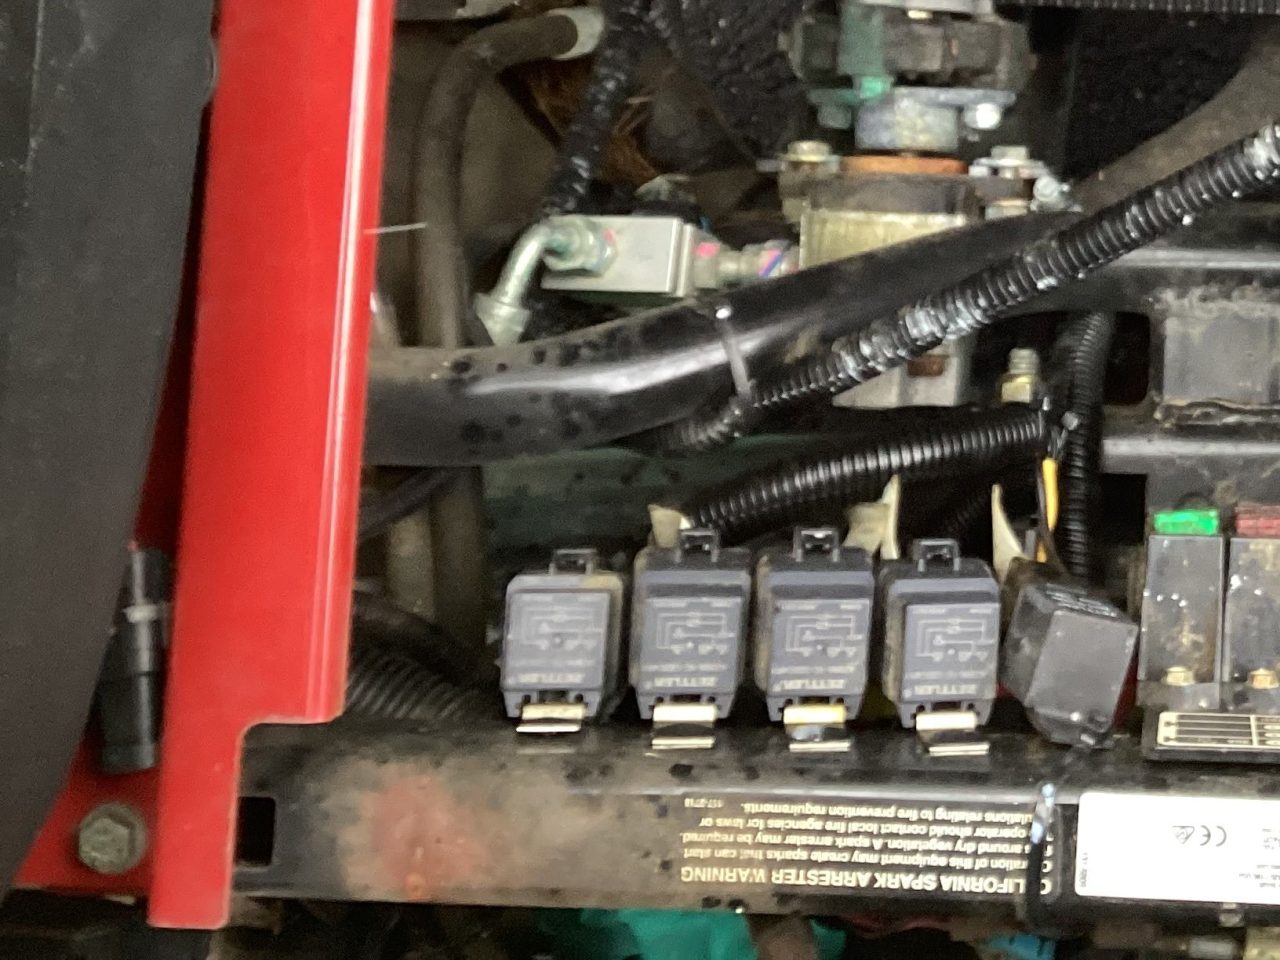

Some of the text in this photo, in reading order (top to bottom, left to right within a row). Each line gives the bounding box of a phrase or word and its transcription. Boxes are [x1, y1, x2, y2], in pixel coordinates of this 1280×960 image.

[740, 802, 827, 816] requirements.
[828, 804, 896, 818] prevention
[897, 809, 919, 822] fire
[919, 809, 934, 822] to
[934, 807, 983, 823] relating
[699, 817, 713, 827] or
[715, 817, 744, 829] laws
[746, 818, 765, 830] for
[767, 817, 823, 831] agencies
[824, 821, 847, 833] fire
[848, 822, 879, 834] local
[879, 823, 928, 835] contact
[929, 825, 973, 838] should
[973, 826, 1028, 839] operator
[679, 831, 734, 843] required.
[736, 833, 753, 845] be
[754, 832, 782, 845] may
[783, 835, 833, 847] arrester
[834, 835, 870, 848] spark
[872, 839, 883, 851] A
[883, 838, 954, 852] vegetation.
[954, 839, 976, 854] dry
[977, 842, 1023, 855] around
[683, 848, 1053, 873] Oration of this equipment may create sparks that can start
[680, 866, 1052, 895] CLIFORNIA SPARK ARRESTER WARNING
